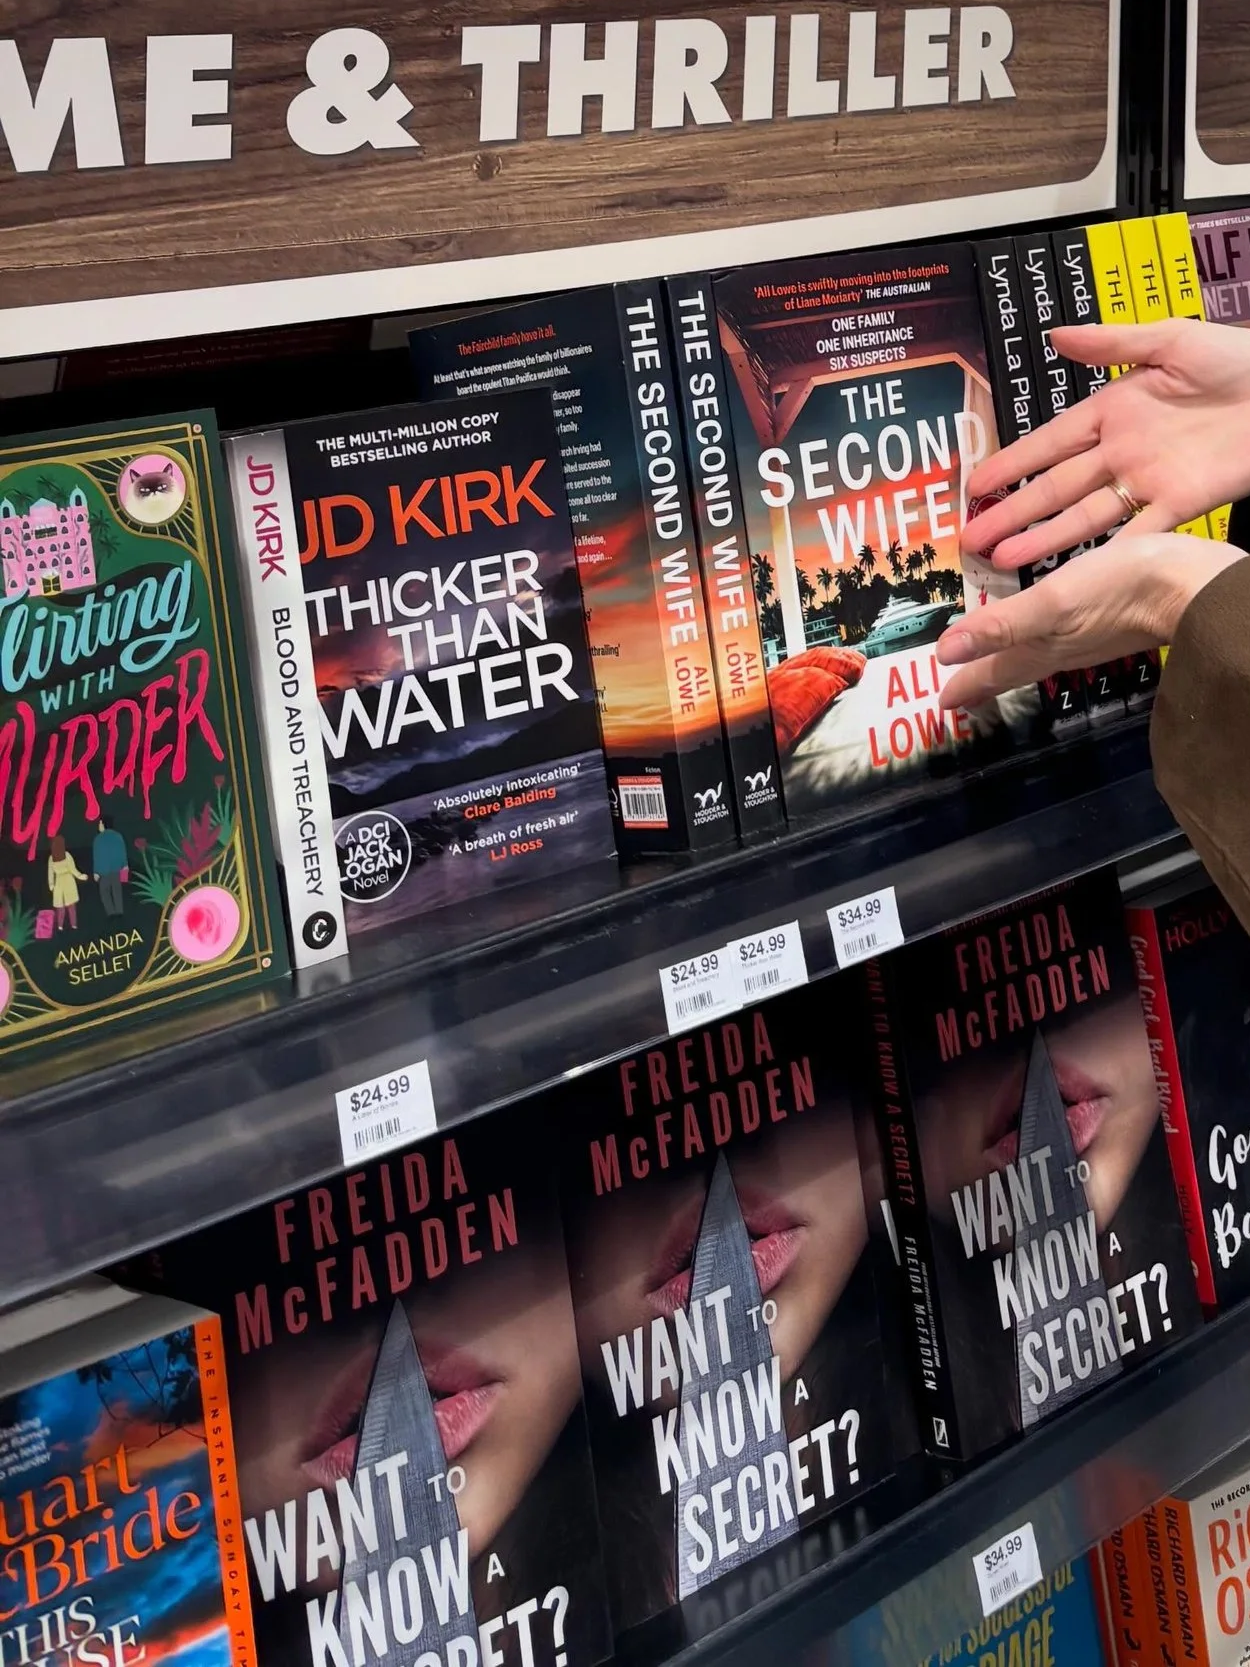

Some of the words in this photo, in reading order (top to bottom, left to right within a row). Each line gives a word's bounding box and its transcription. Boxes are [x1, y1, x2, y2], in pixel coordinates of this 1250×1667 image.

[286, 27, 420, 155] &
[461, 5, 1016, 141] THRILLER
[771, 282, 797, 297] Lowe
[807, 276, 839, 292] swiftly
[840, 272, 873, 289] moving
[891, 268, 907, 281] the
[907, 263, 949, 279] footprints
[1063, 243, 1093, 317] Lynda
[1141, 259, 1160, 308] THE
[1174, 253, 1194, 301] THE
[1191, 230, 1240, 283] ALF
[784, 298, 795, 311] of
[796, 295, 821, 309] Liane
[865, 288, 881, 299] THE
[882, 281, 931, 297] AUSTRALIAN
[988, 255, 1018, 331] Lynda
[1003, 336, 1023, 372] La
[1025, 248, 1054, 323] Lynda
[1040, 329, 1059, 363] La
[1105, 265, 1126, 314] THE
[626, 298, 662, 373] THE
[678, 290, 713, 364] THE
[816, 338, 840, 354] ONE
[842, 326, 915, 350] INHERITANCE
[831, 316, 855, 332] ONE
[857, 310, 896, 329] FAMILY
[560, 344, 592, 360] billionaires
[829, 355, 849, 371] SIX
[850, 346, 907, 367] SUSPECTS
[553, 388, 581, 401] disappear
[840, 379, 906, 424] THE
[316, 435, 346, 453] THE
[350, 418, 458, 448] MULTI-MILLION
[461, 411, 500, 429] COPY
[330, 441, 428, 468] BESTSELLING
[432, 431, 492, 452] AUTHOR
[637, 381, 684, 540] SECOND
[689, 373, 734, 529] SECOND
[757, 411, 986, 508] SECOND
[247, 454, 275, 496] JD
[577, 457, 611, 472] succession
[252, 501, 287, 583] KIRK
[299, 494, 374, 565] JD
[388, 459, 557, 545] KIRK
[817, 481, 956, 564] WIFE
[304, 549, 544, 637] THICKER
[660, 546, 699, 647] WIFE
[711, 535, 749, 633] WIFE
[272, 606, 300, 699] BLOOD
[388, 596, 548, 671] THAN
[40, 665, 115, 714] WITH
[674, 656, 696, 715] LOWE
[694, 665, 711, 697] ALI
[724, 641, 746, 700] LOWE
[742, 650, 760, 682] ALI
[887, 654, 940, 708] ALI
[320, 641, 580, 759] WATER
[284, 705, 311, 756] AND
[868, 707, 972, 767] LOWE
[292, 760, 324, 897] TREACHERY
[358, 821, 391, 844] DCI
[463, 801, 501, 820] Clare
[504, 787, 557, 809] Balding
[344, 836, 393, 865] JACK
[465, 831, 506, 852] breath
[509, 825, 523, 839] of
[525, 818, 556, 836] fresh
[490, 848, 507, 863] LJ
[510, 838, 544, 856] Ross
[340, 849, 403, 883] LOGAN
[353, 870, 390, 892] Novel
[838, 898, 881, 927] $34.99
[53, 928, 144, 970] AMANDA
[69, 952, 134, 986] SELLET
[670, 954, 719, 985] $24.99
[739, 933, 786, 961] $24.99
[955, 904, 1075, 992] FREIDA
[935, 945, 1111, 1062] McFADDEN
[350, 1075, 410, 1113] $24.99
[620, 1012, 775, 1116] FREIDA
[877, 1040, 900, 1095] KNOW
[590, 1056, 816, 1196] McFADDEN
[274, 1139, 468, 1263] FREIDA
[951, 1145, 1056, 1260] WANT
[1063, 1160, 1091, 1190] TO
[235, 1188, 519, 1354] McFADDEN
[993, 1209, 1100, 1331] KNOW
[1109, 1231, 1122, 1257] A
[904, 1236, 923, 1294] FREIDA
[914, 1303, 937, 1391] McFADDEN
[1022, 1262, 1172, 1406] SECRET?
[201, 1335, 216, 1378] THE
[600, 1285, 731, 1417] WANT
[747, 1299, 777, 1332] TO
[208, 1396, 231, 1499] INSTANT
[652, 1355, 781, 1495] KNOW
[794, 1378, 809, 1406] A
[683, 1409, 860, 1575] SECRET?
[244, 1450, 408, 1603] WANT
[427, 1465, 466, 1502] TO
[984, 1535, 1023, 1572] $34.99
[223, 1518, 242, 1612] SUNDAY
[1113, 1549, 1134, 1618] OSMAN
[1164, 1506, 1187, 1587] RICHARD
[1176, 1589, 1197, 1660] OSMAN
[306, 1527, 470, 1667] KNOW
[487, 1552, 505, 1584] A
[1151, 1565, 1171, 1634] OSMAN
